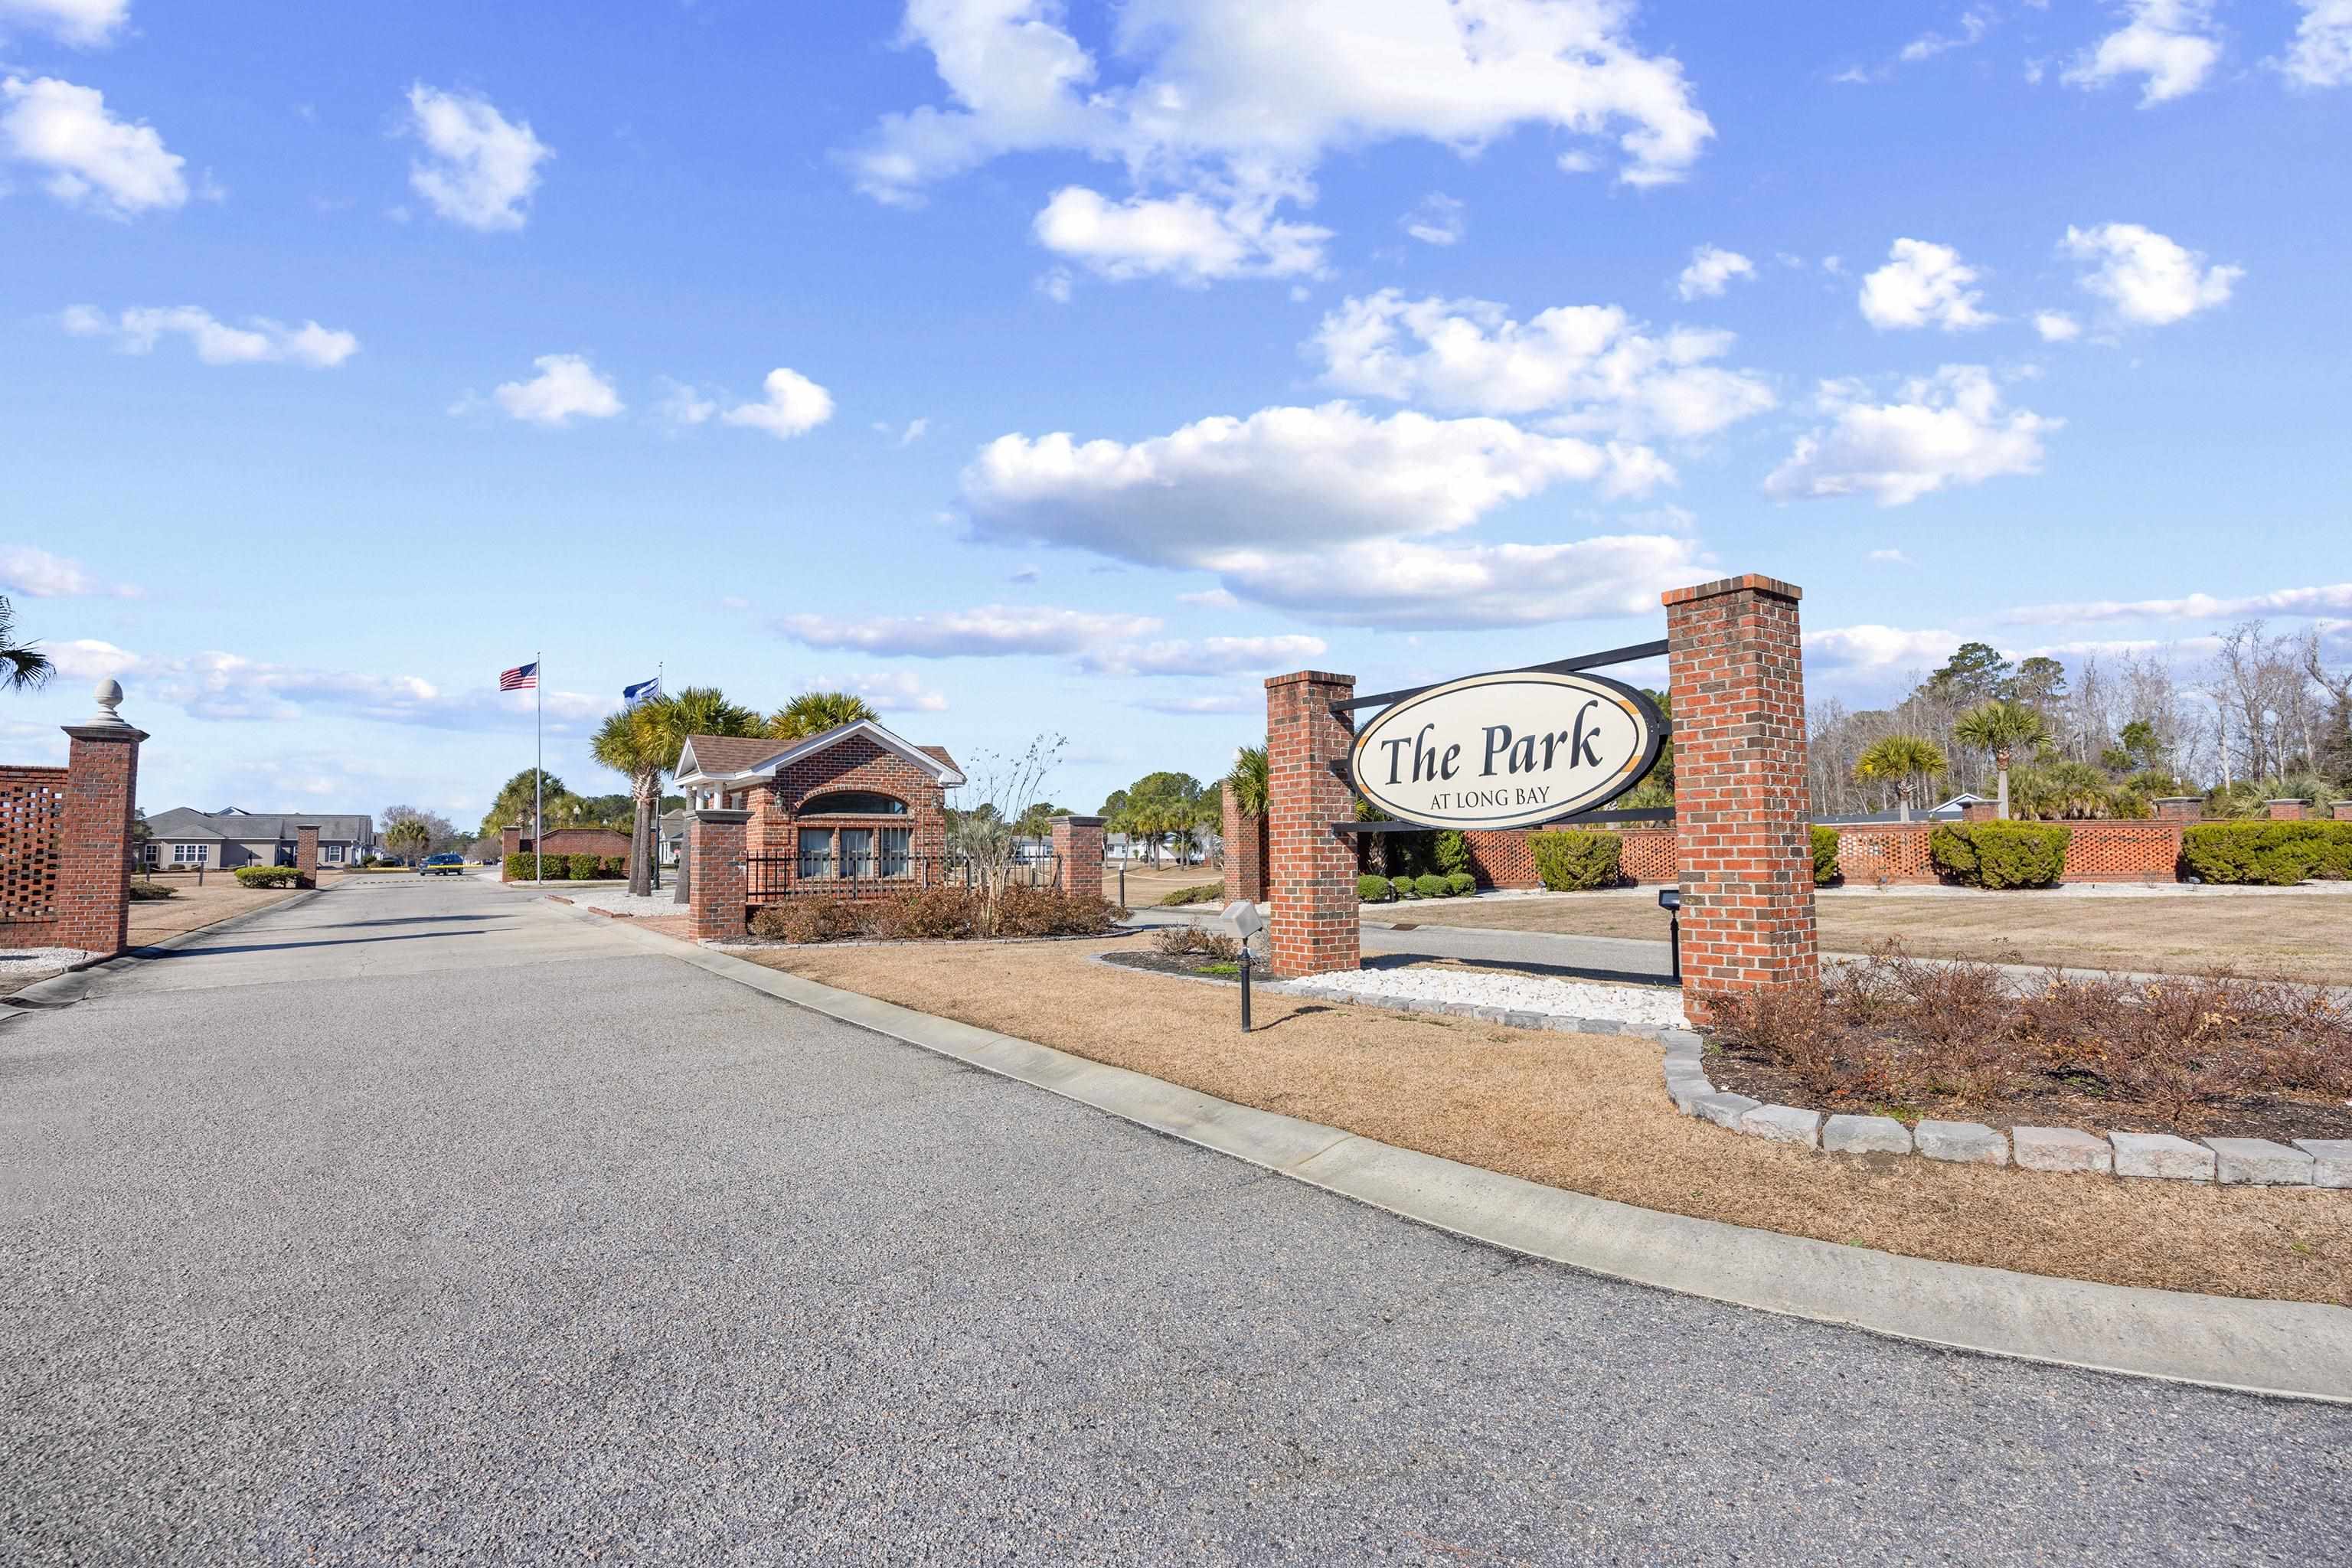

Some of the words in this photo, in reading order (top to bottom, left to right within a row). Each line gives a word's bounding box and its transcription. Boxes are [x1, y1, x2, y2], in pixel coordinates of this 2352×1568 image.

[1380, 723, 1461, 786] The
[1478, 700, 1603, 778] Park
[1430, 793, 1451, 810] AT
[1457, 789, 1508, 808] LONG
[1516, 786, 1550, 805] BAY
